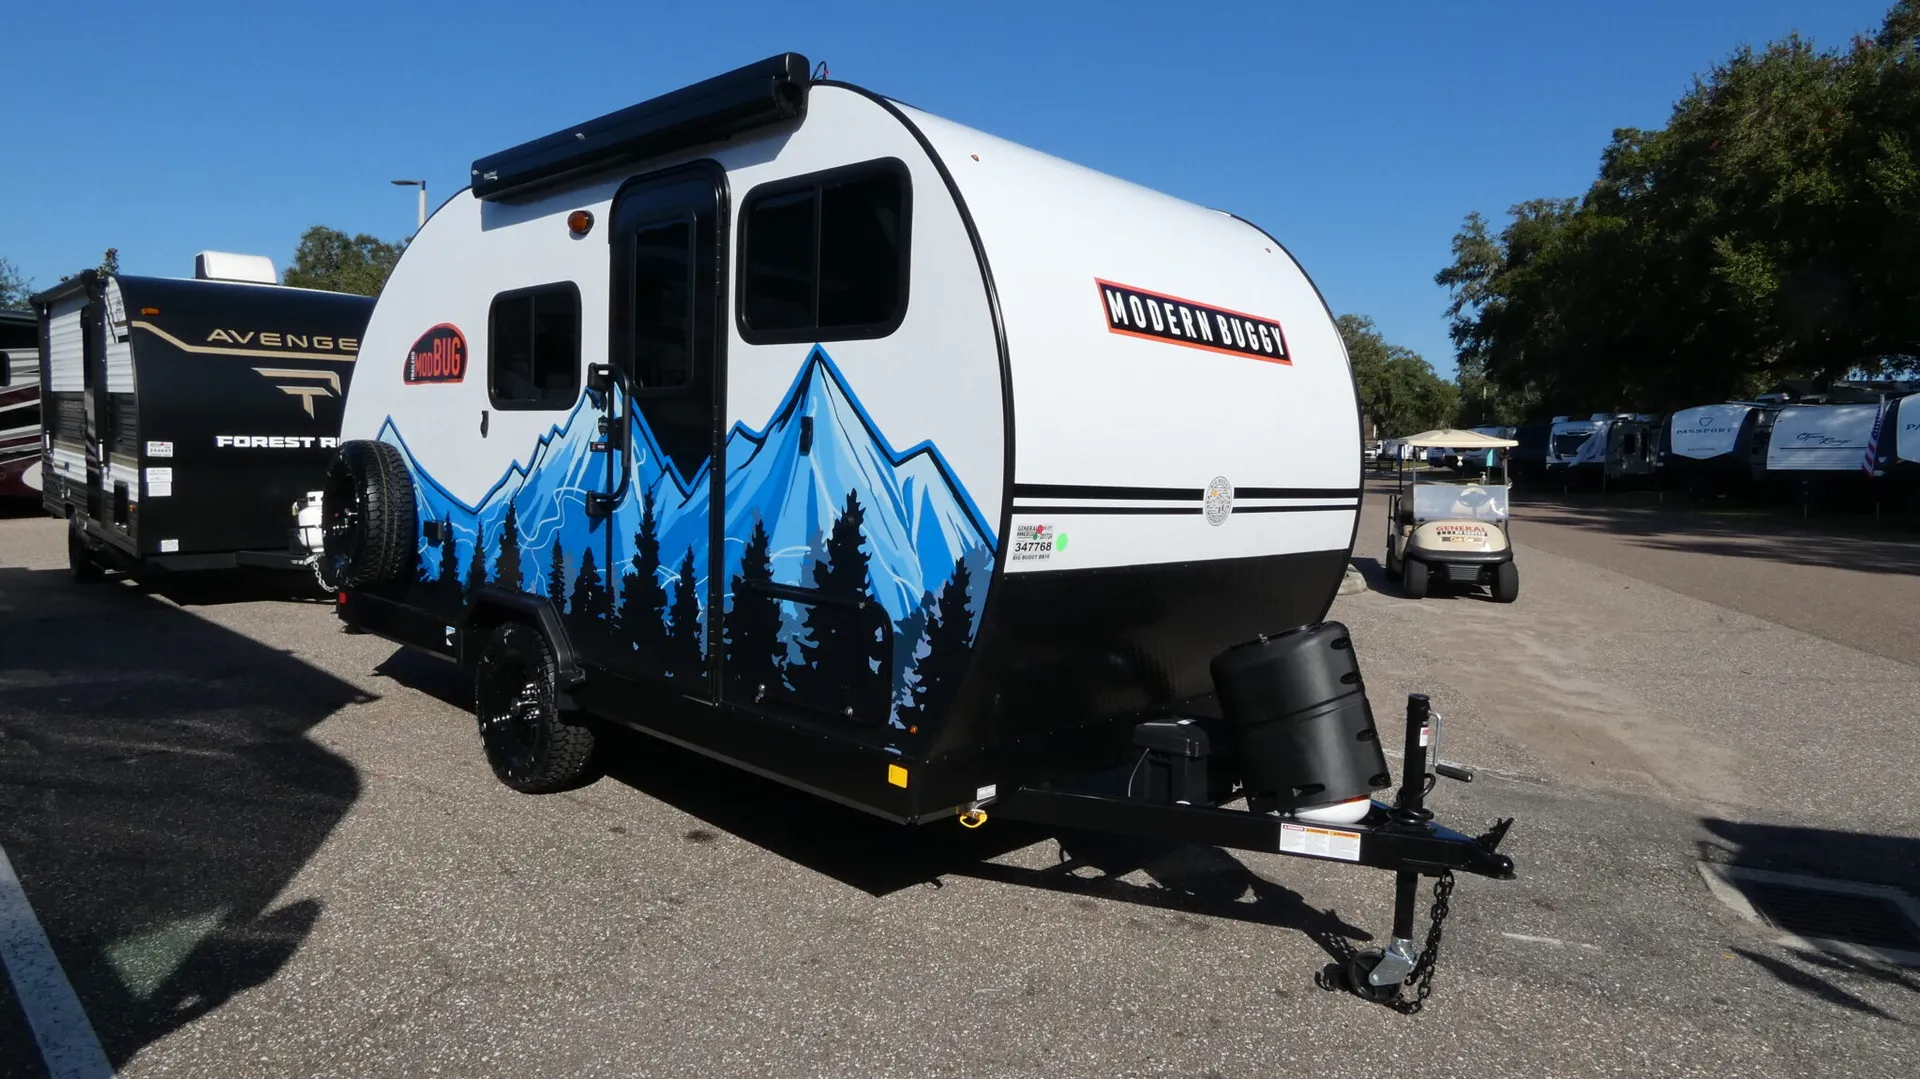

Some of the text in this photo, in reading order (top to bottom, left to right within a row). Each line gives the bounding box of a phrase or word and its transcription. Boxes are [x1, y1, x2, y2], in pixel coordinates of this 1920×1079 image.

[1105, 289, 1284, 356] MODERN BUGGY
[206, 328, 359, 351] AVENGE
[1676, 427, 1733, 435] PASSPORT
[216, 435, 316, 448] FOREST
[1015, 541, 1052, 552] 347768
